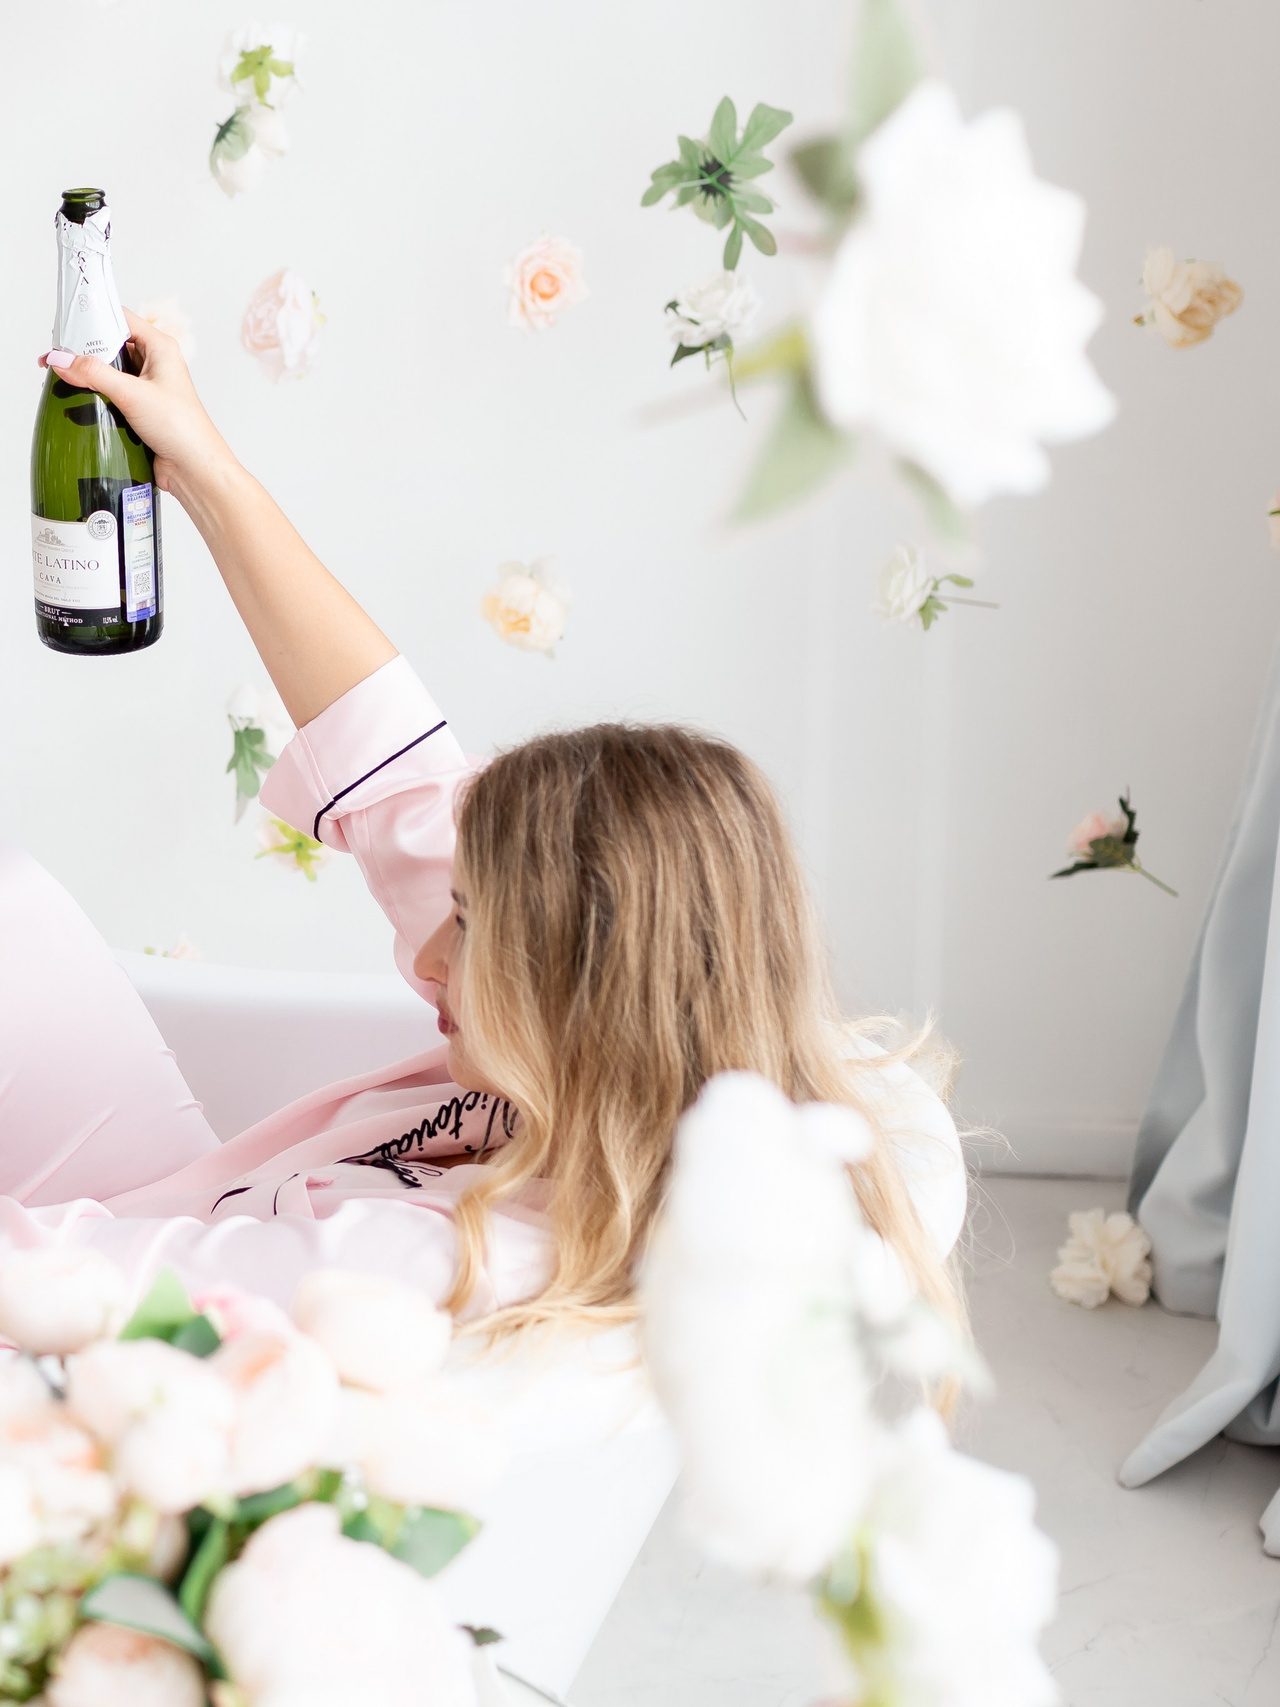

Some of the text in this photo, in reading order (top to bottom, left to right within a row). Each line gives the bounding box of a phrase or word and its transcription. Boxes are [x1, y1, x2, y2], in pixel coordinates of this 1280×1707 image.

[85, 339, 104, 347] ARTE
[83, 347, 108, 355] LATINO
[45, 555, 99, 571] LATINO
[39, 572, 61, 584] CAVA
[44, 606, 61, 616] BRUT
